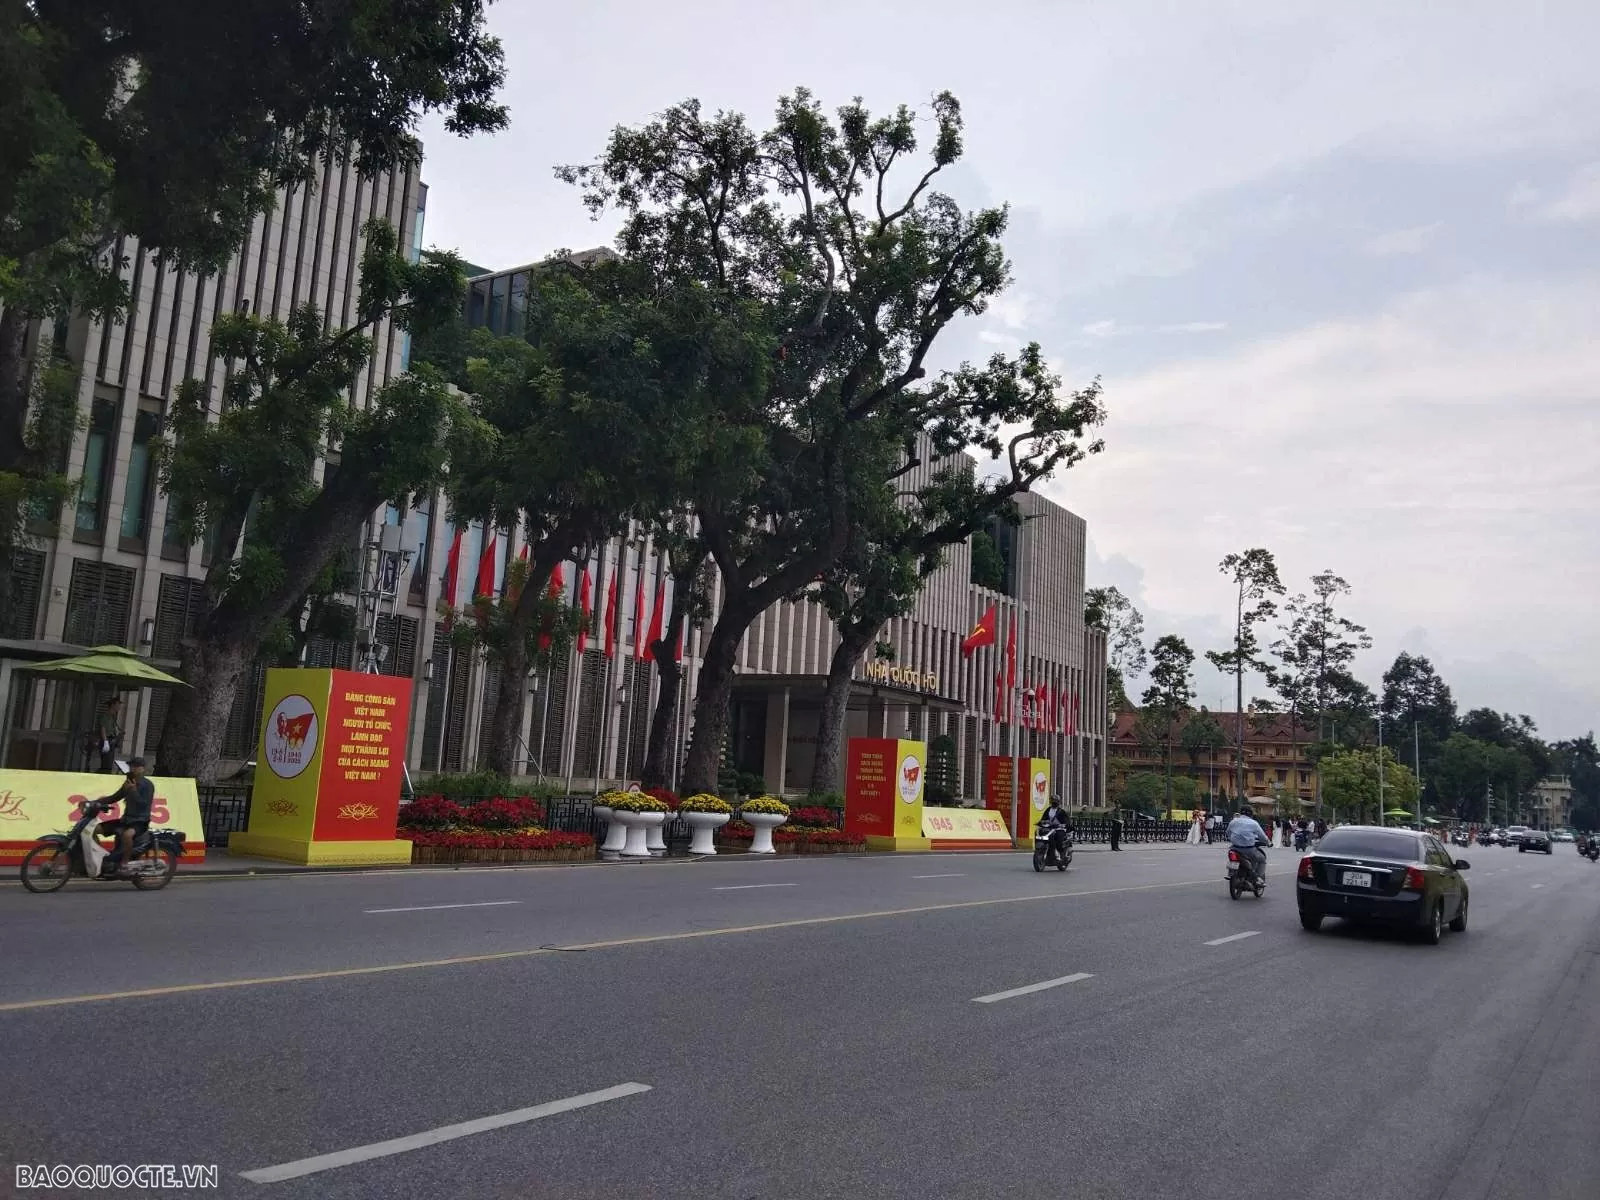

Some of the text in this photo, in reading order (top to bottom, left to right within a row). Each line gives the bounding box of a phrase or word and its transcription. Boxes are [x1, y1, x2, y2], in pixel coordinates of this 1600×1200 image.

[370, 708, 385, 717] NAM
[360, 771, 377, 780] NAM
[929, 816, 1002, 832] 1945 2025
